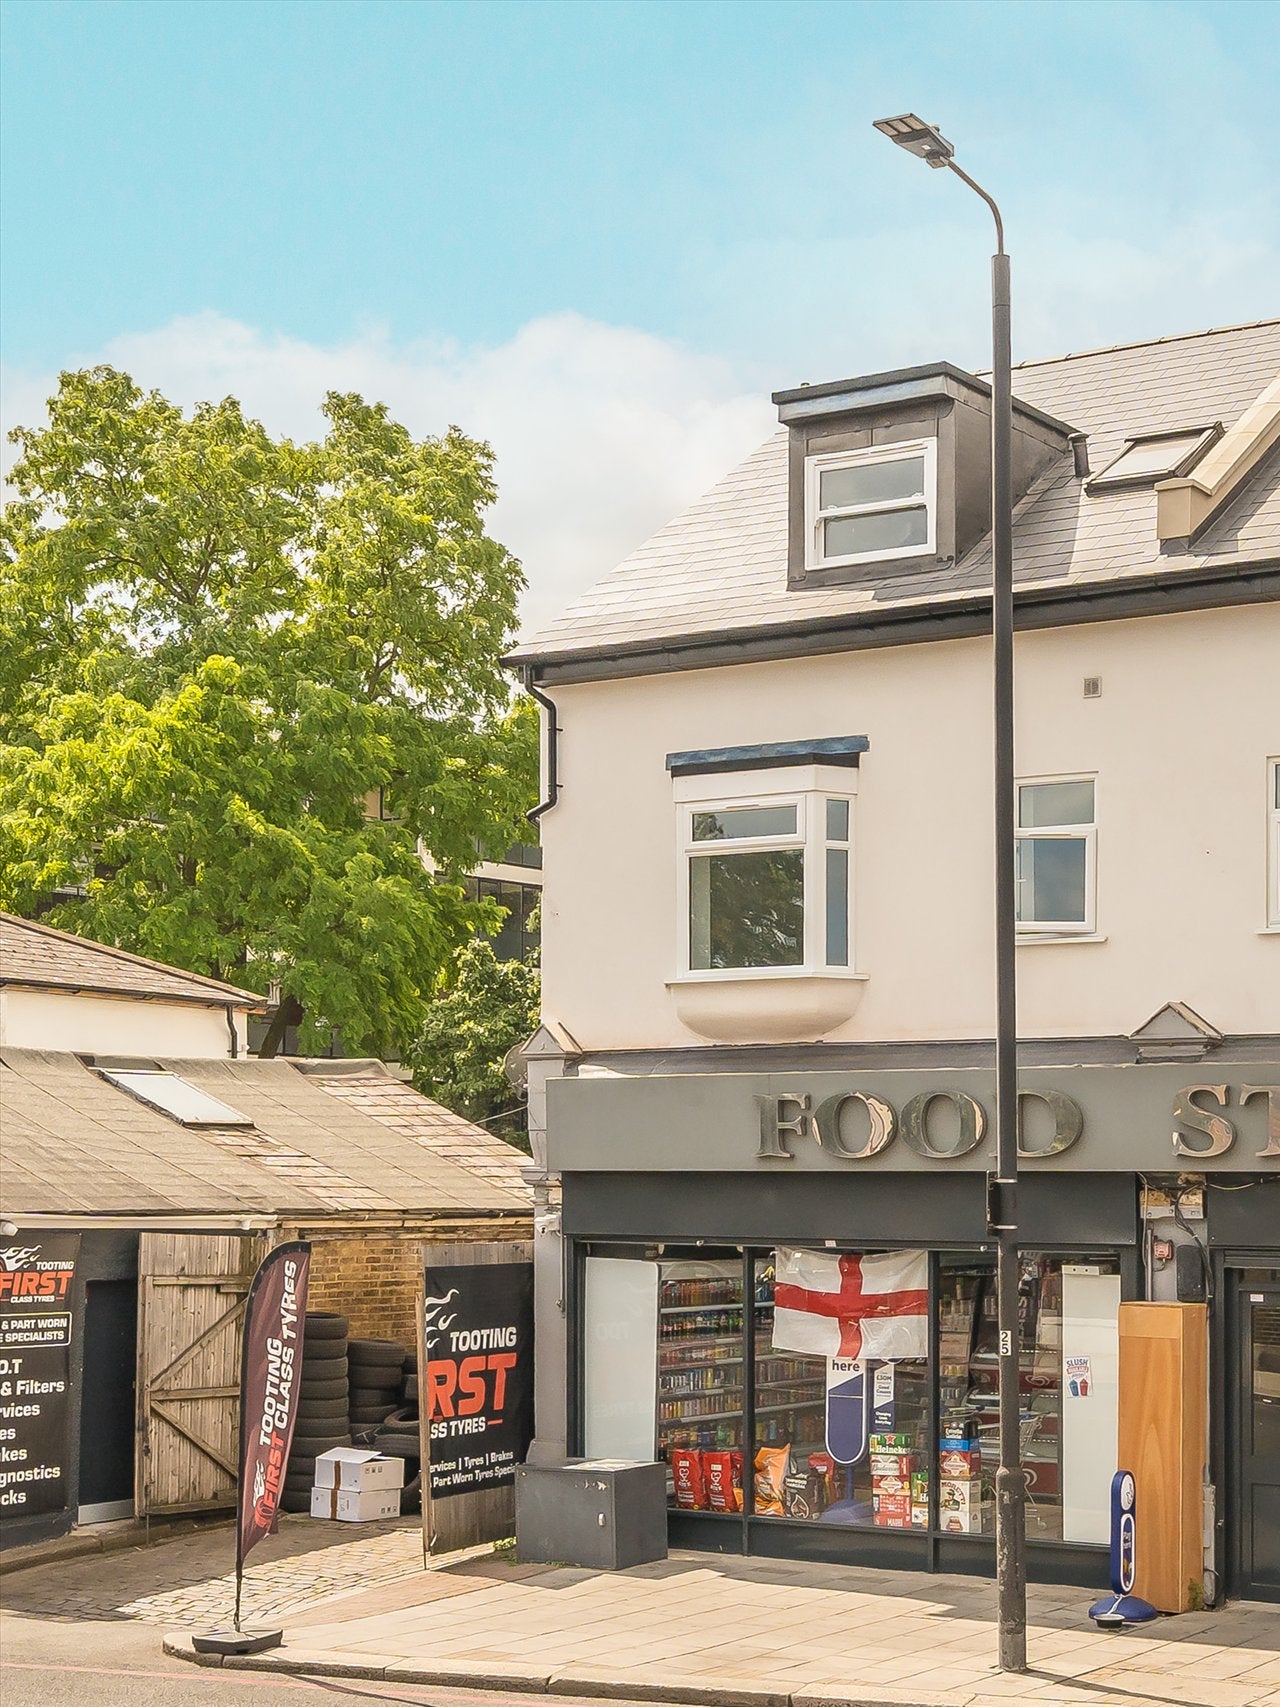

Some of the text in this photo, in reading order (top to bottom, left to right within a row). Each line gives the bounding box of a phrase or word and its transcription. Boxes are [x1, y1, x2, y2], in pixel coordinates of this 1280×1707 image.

[753, 1089, 1084, 1160] FOOD
[36, 1261, 75, 1271] TOOTING
[0, 1271, 74, 1297] FIRST
[10, 1295, 56, 1304] CLASS TYRES
[11, 1319, 36, 1330] PART
[38, 1318, 67, 1328] WORN
[5, 1331, 65, 1343] SPECIALISTS
[450, 1326, 517, 1352] TOOTING
[832, 1360, 860, 1372] here
[1066, 1359, 1088, 1368] SLUSH
[0, 1379, 65, 1397] & Filters
[260, 1337, 283, 1446] TOOTING
[263, 1260, 297, 1507] FIRST CLASS TYRES
[449, 1416, 486, 1437] TYRES
[464, 1456, 484, 1469] Tyres
[490, 1450, 514, 1463] Brakes
[433, 1476, 452, 1488] Part
[452, 1472, 474, 1485] Worn
[474, 1469, 494, 1482] Tyres
